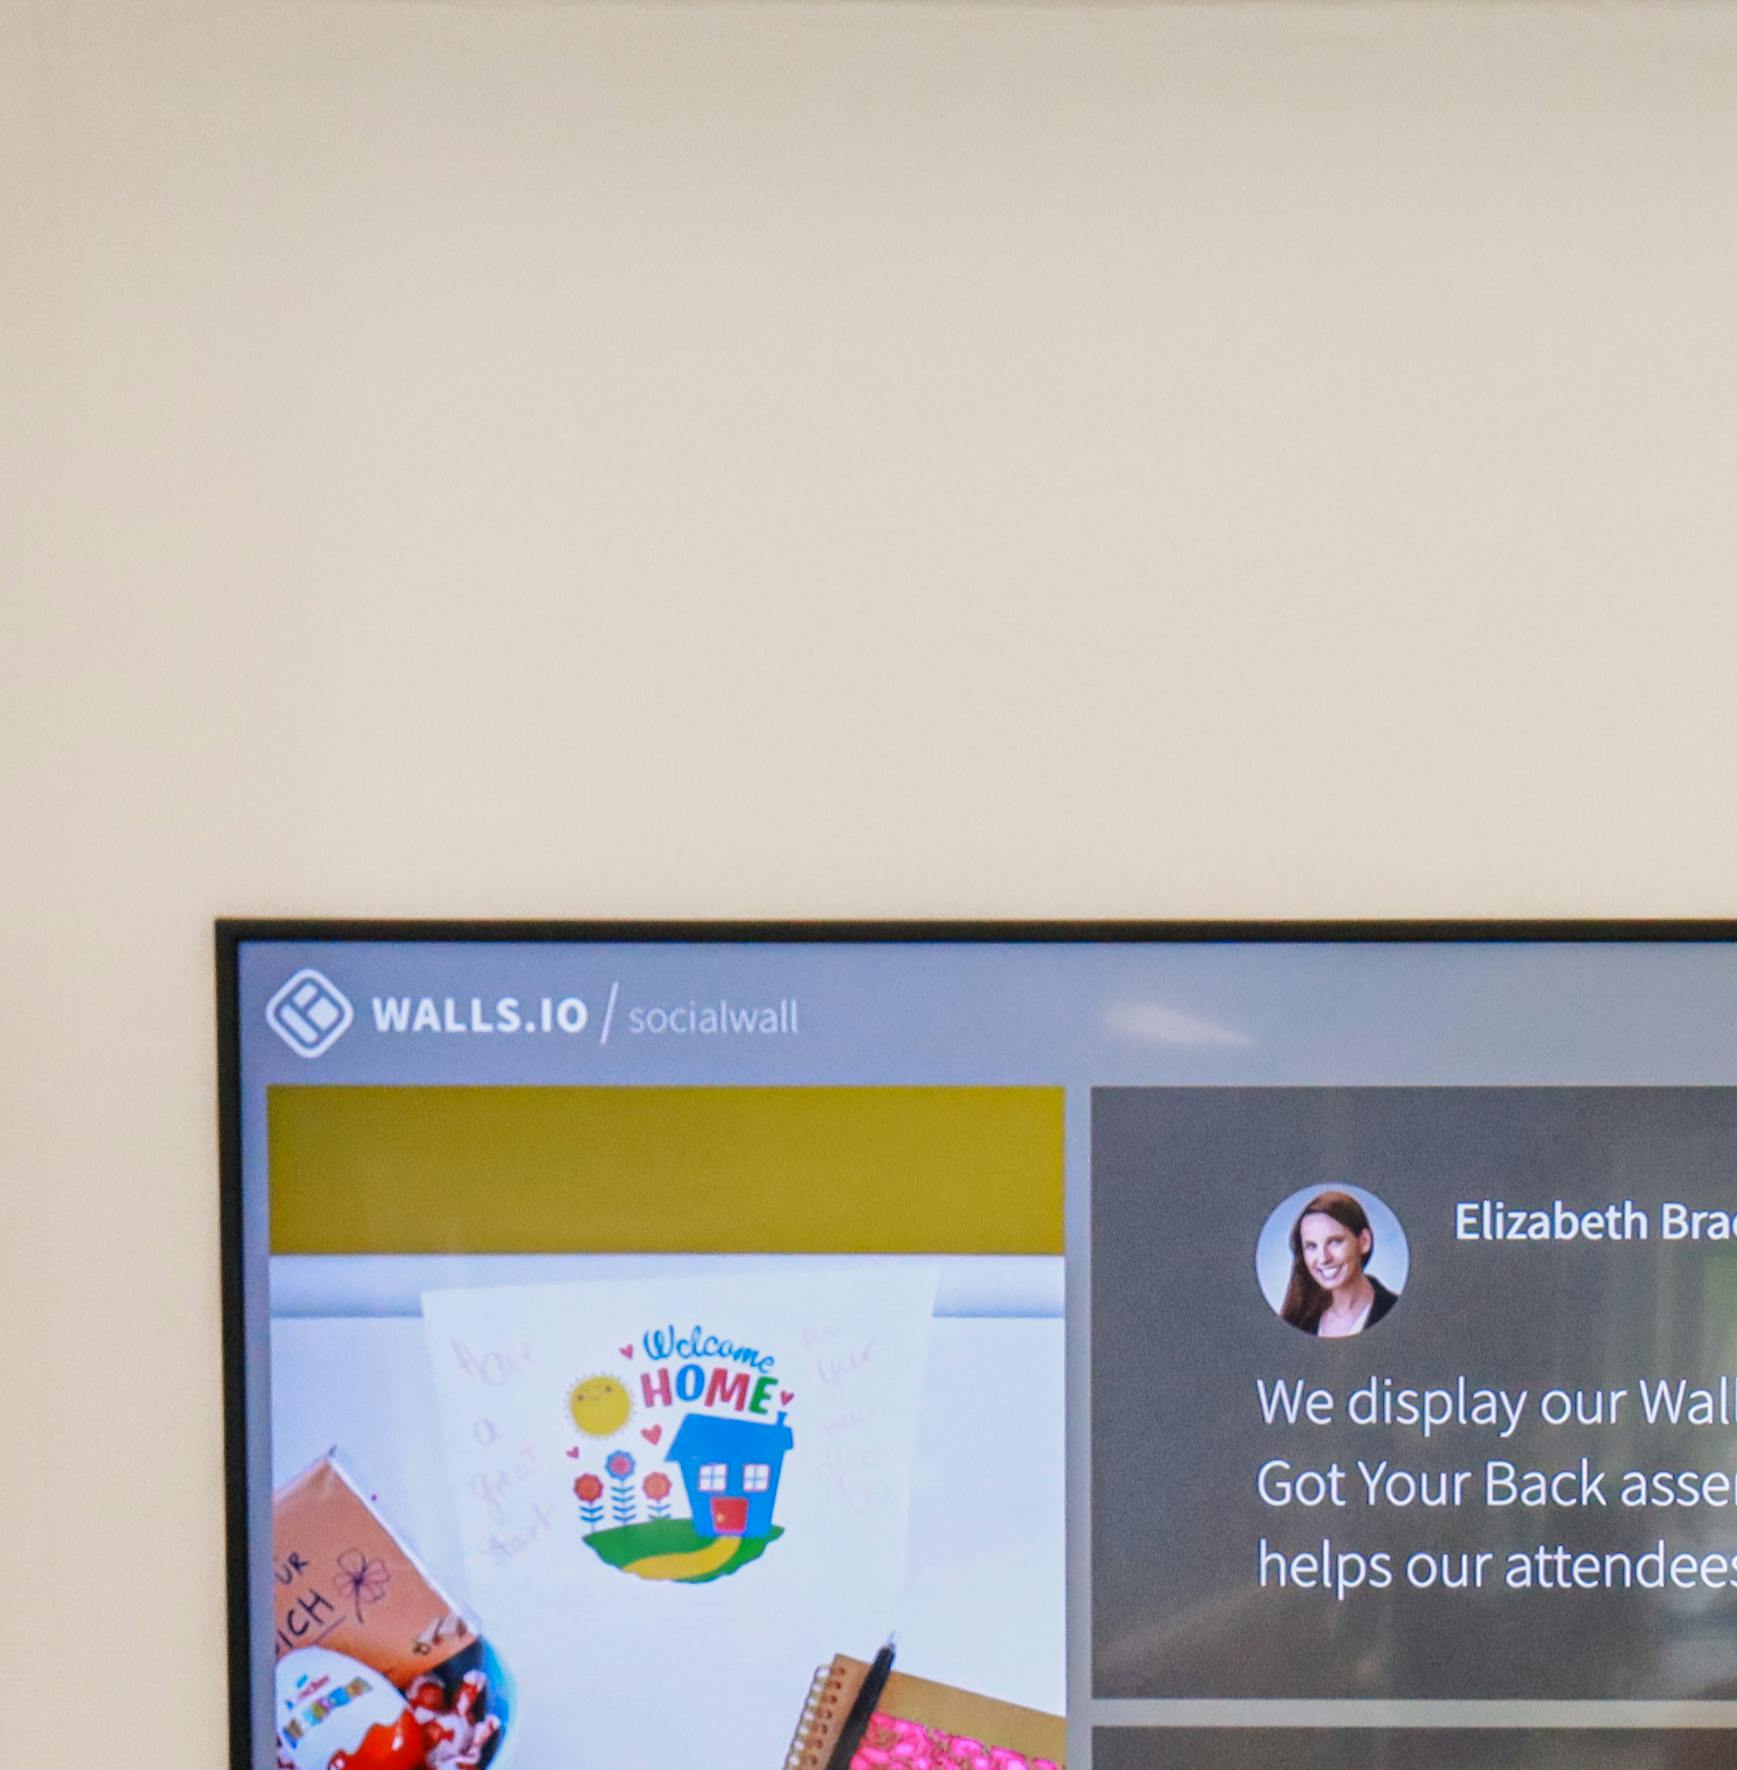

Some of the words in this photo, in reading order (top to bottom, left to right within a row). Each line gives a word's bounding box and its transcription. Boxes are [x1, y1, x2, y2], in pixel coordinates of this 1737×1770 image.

[372, 997, 589, 1035] WALLS.IO
[629, 999, 799, 1035] socialwall
[1455, 1200, 1650, 1242] Elizabeth
[643, 1324, 776, 1374] Welcome
[640, 1363, 779, 1414] HOME
[1257, 1379, 1336, 1426] We
[1348, 1376, 1528, 1438] display
[1541, 1390, 1628, 1426] our
[1257, 1460, 1348, 1508] Got
[1357, 1461, 1474, 1508] Your
[1486, 1458, 1609, 1508] Back
[1259, 1539, 1394, 1602] helps
[1407, 1553, 1494, 1590] our
[275, 1588, 336, 1652] ICH
